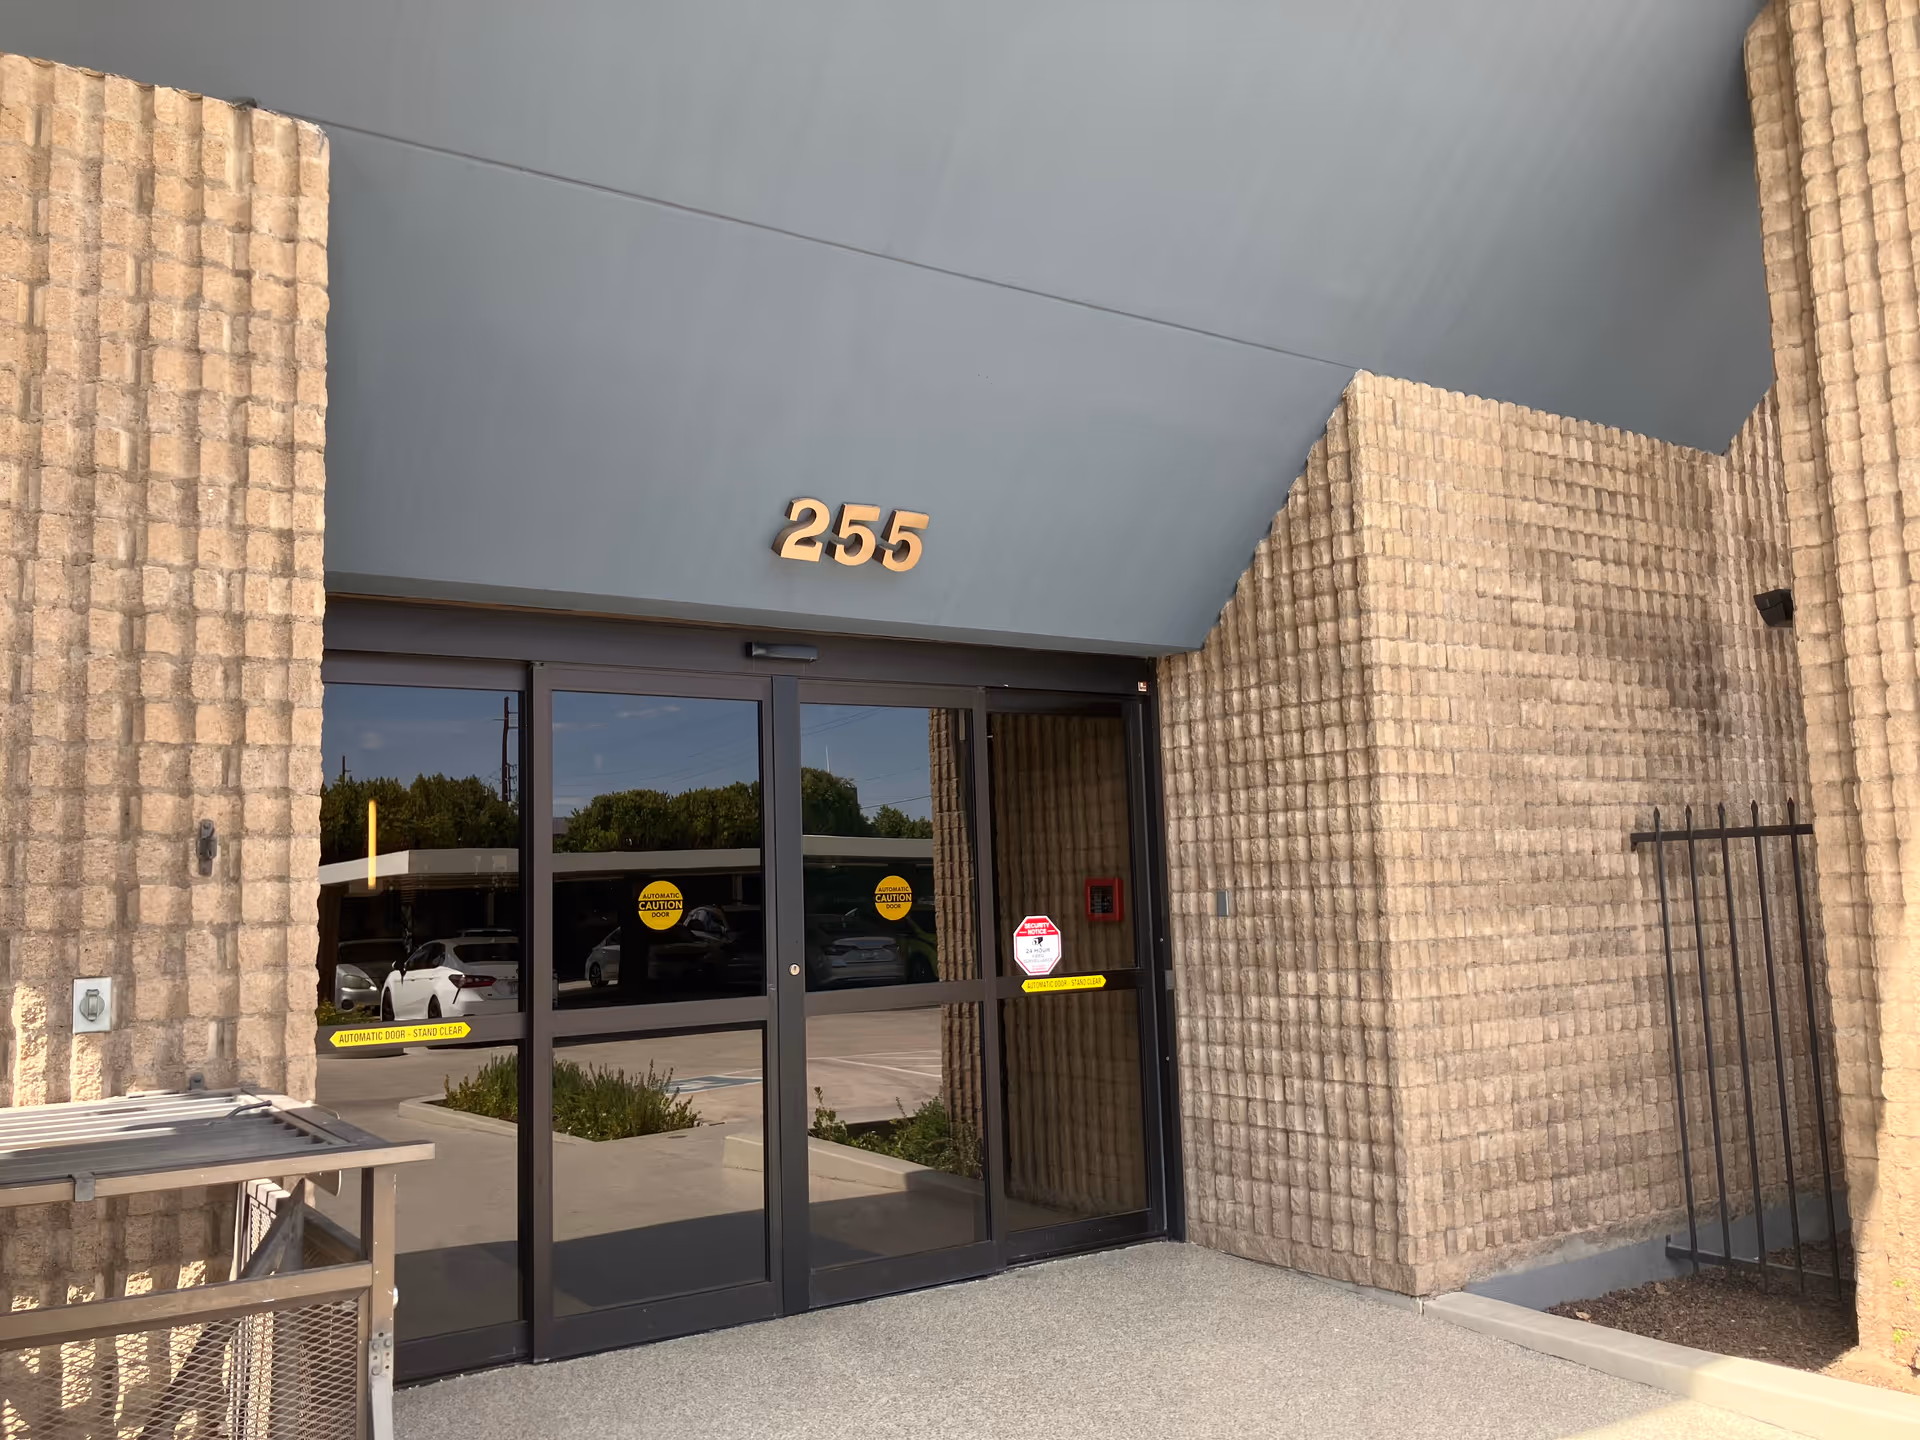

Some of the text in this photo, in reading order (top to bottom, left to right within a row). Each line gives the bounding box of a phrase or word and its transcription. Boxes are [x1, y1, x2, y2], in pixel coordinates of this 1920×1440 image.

[771, 497, 930, 572] 255
[875, 894, 912, 902] CAUTION
[638, 900, 683, 910] CAUTION
[1027, 980, 1054, 989] AUTOMATIC
[1054, 979, 1068, 988] DOOR
[1071, 978, 1087, 987] STAND
[1087, 976, 1102, 985] CLEAR
[339, 1031, 383, 1044] AUTOMATIC
[385, 1030, 406, 1040] DOOR
[413, 1028, 438, 1038] STAND
[439, 1026, 463, 1036] CLEAR
